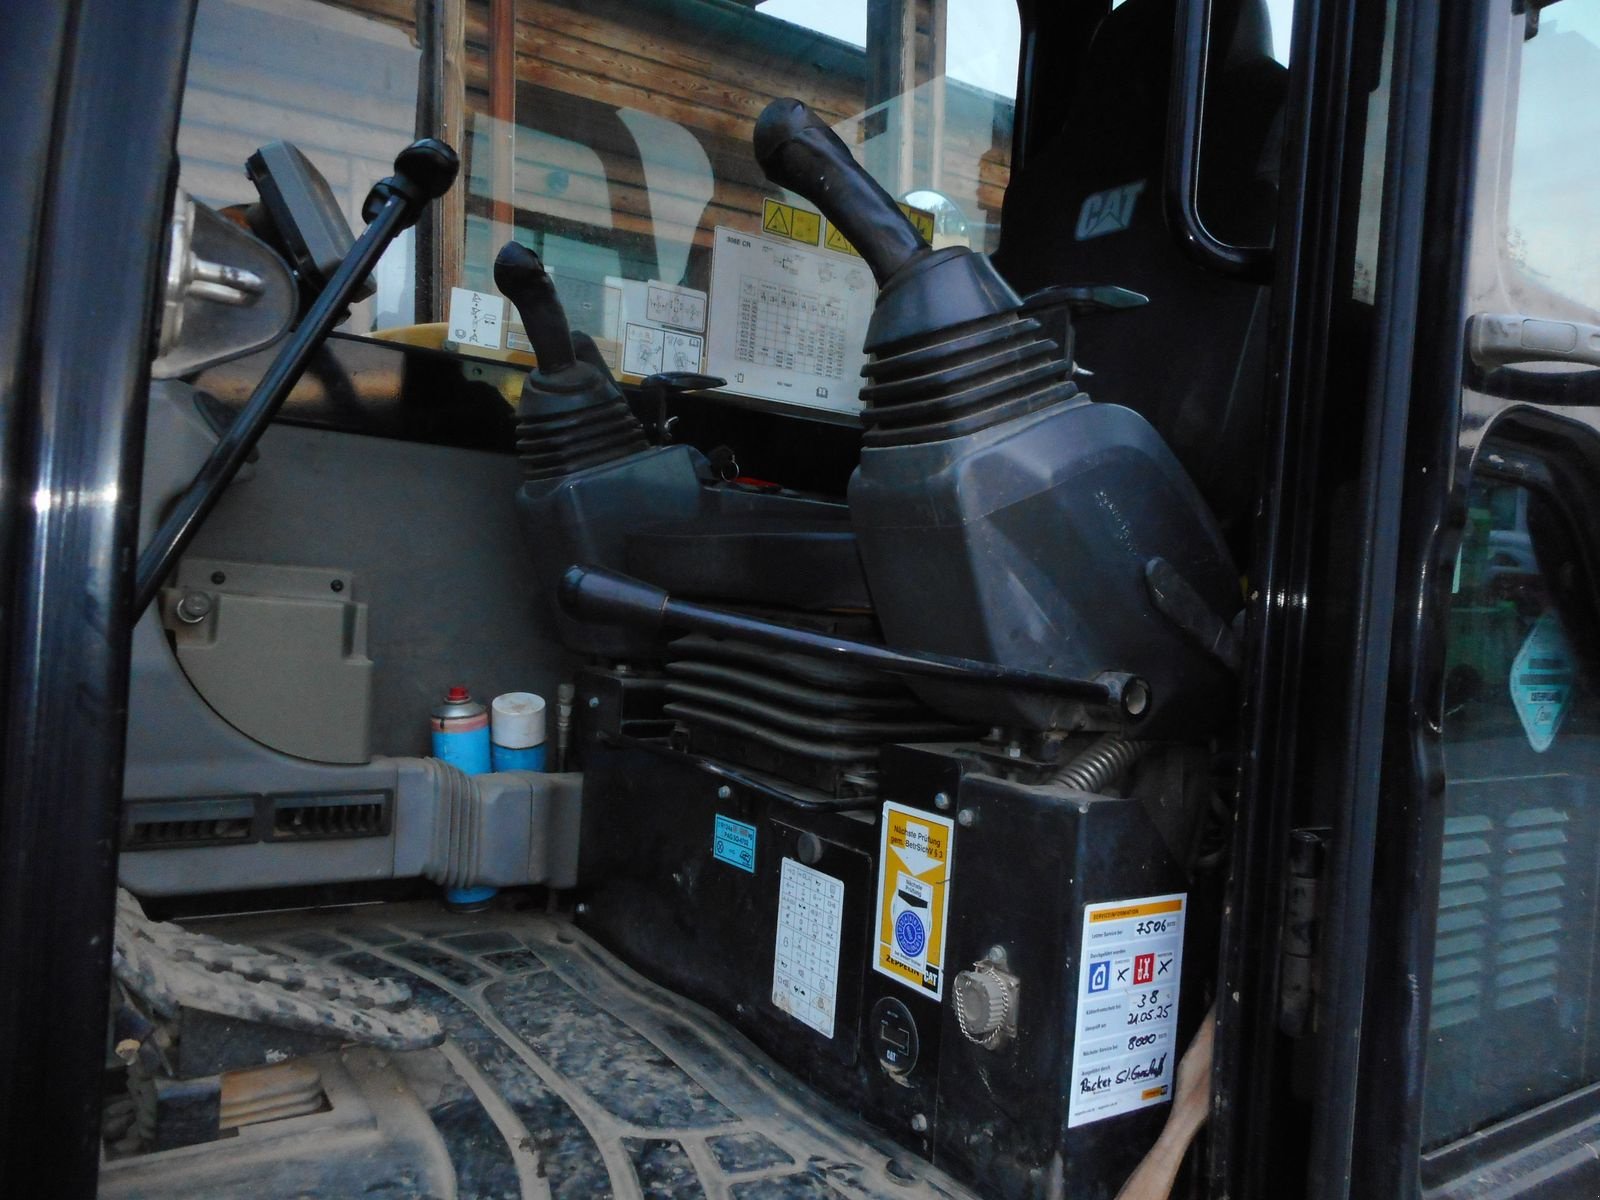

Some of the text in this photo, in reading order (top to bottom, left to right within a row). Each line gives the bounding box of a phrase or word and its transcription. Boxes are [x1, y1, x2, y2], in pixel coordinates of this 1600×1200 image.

[1075, 179, 1146, 240] CAT
[890, 836, 904, 846] gem.
[905, 840, 932, 855] BetrSichV
[894, 825, 941, 848] Nächste Prüfung
[1136, 919, 1167, 935] 7506
[923, 970, 939, 987] CAT
[1127, 1003, 1173, 1025] 21.05.25
[1128, 1033, 1157, 1050] 8000
